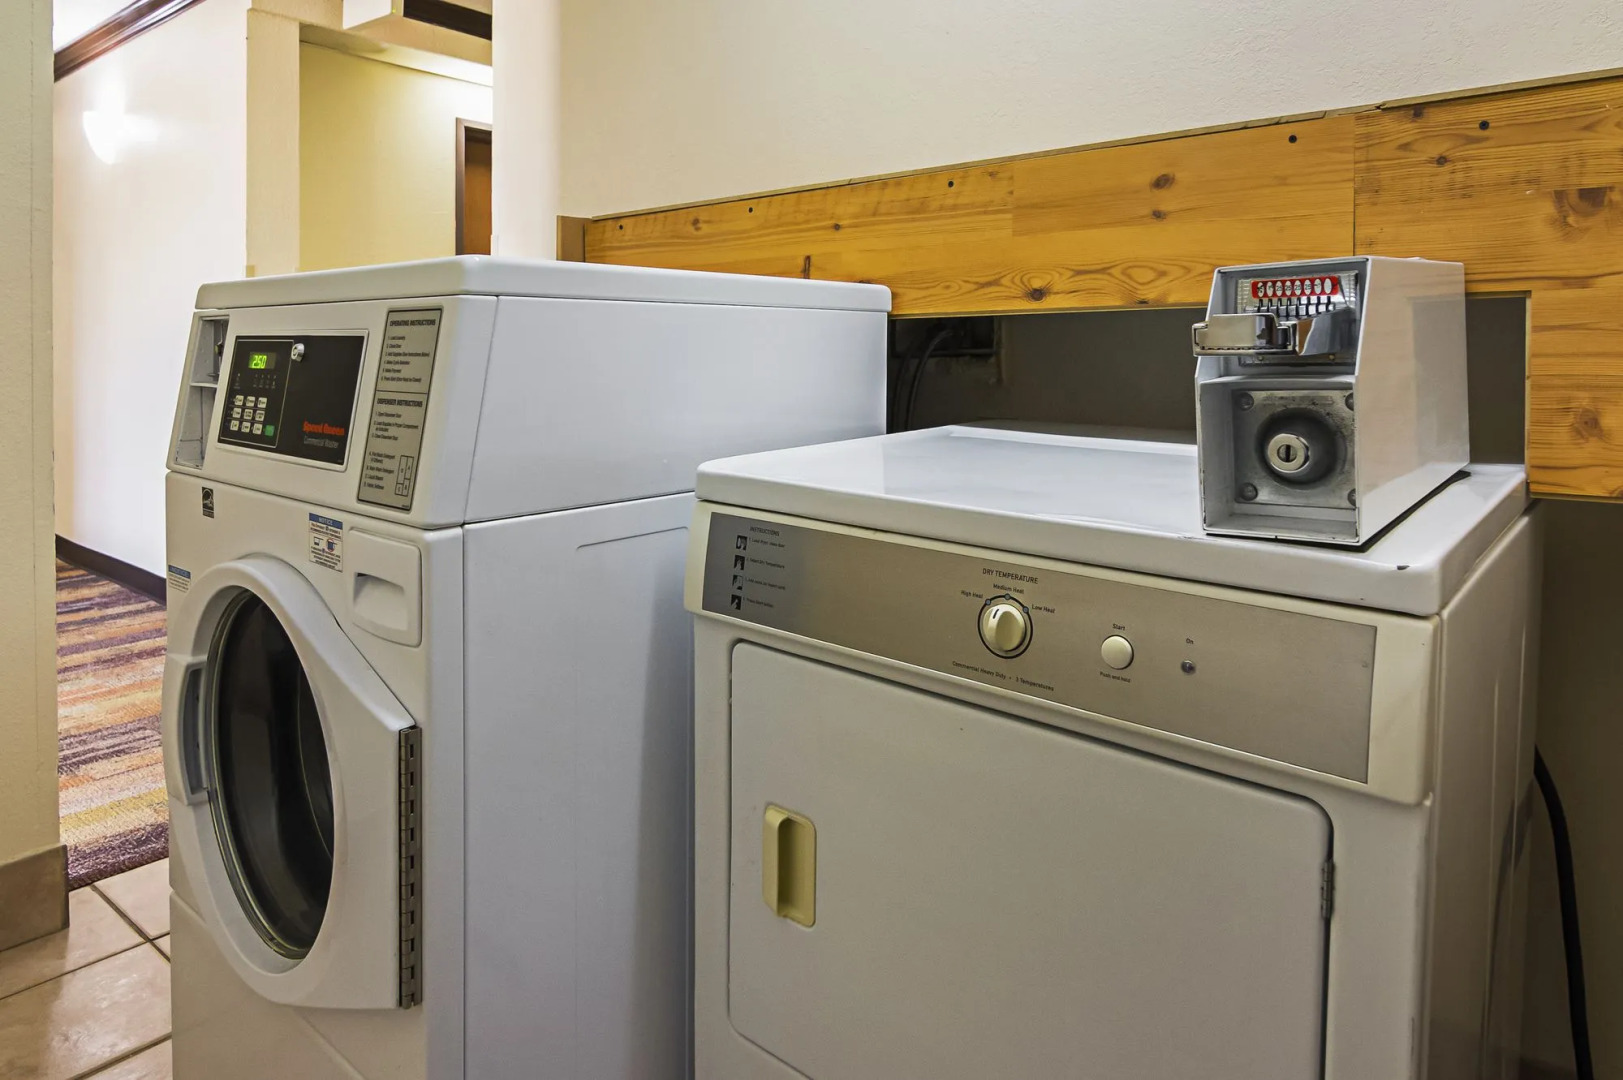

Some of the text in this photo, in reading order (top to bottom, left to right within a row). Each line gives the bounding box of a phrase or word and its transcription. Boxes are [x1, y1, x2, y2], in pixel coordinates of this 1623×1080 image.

[376, 398, 423, 408] DISPENSER INSTRUCTIONS
[304, 436, 324, 446] Commercial
[750, 526, 780, 536] INSTRUCTIONS
[982, 568, 1038, 585] DRY TEMPERATURE
[961, 590, 972, 598] High
[993, 583, 1025, 595] Medium Heat
[1032, 604, 1042, 612] Low
[1112, 623, 1126, 631] Start
[952, 660, 1006, 680] Commercial Heavy Duty
[1100, 671, 1112, 679] Push
[1020, 678, 1054, 692] Temperatures
